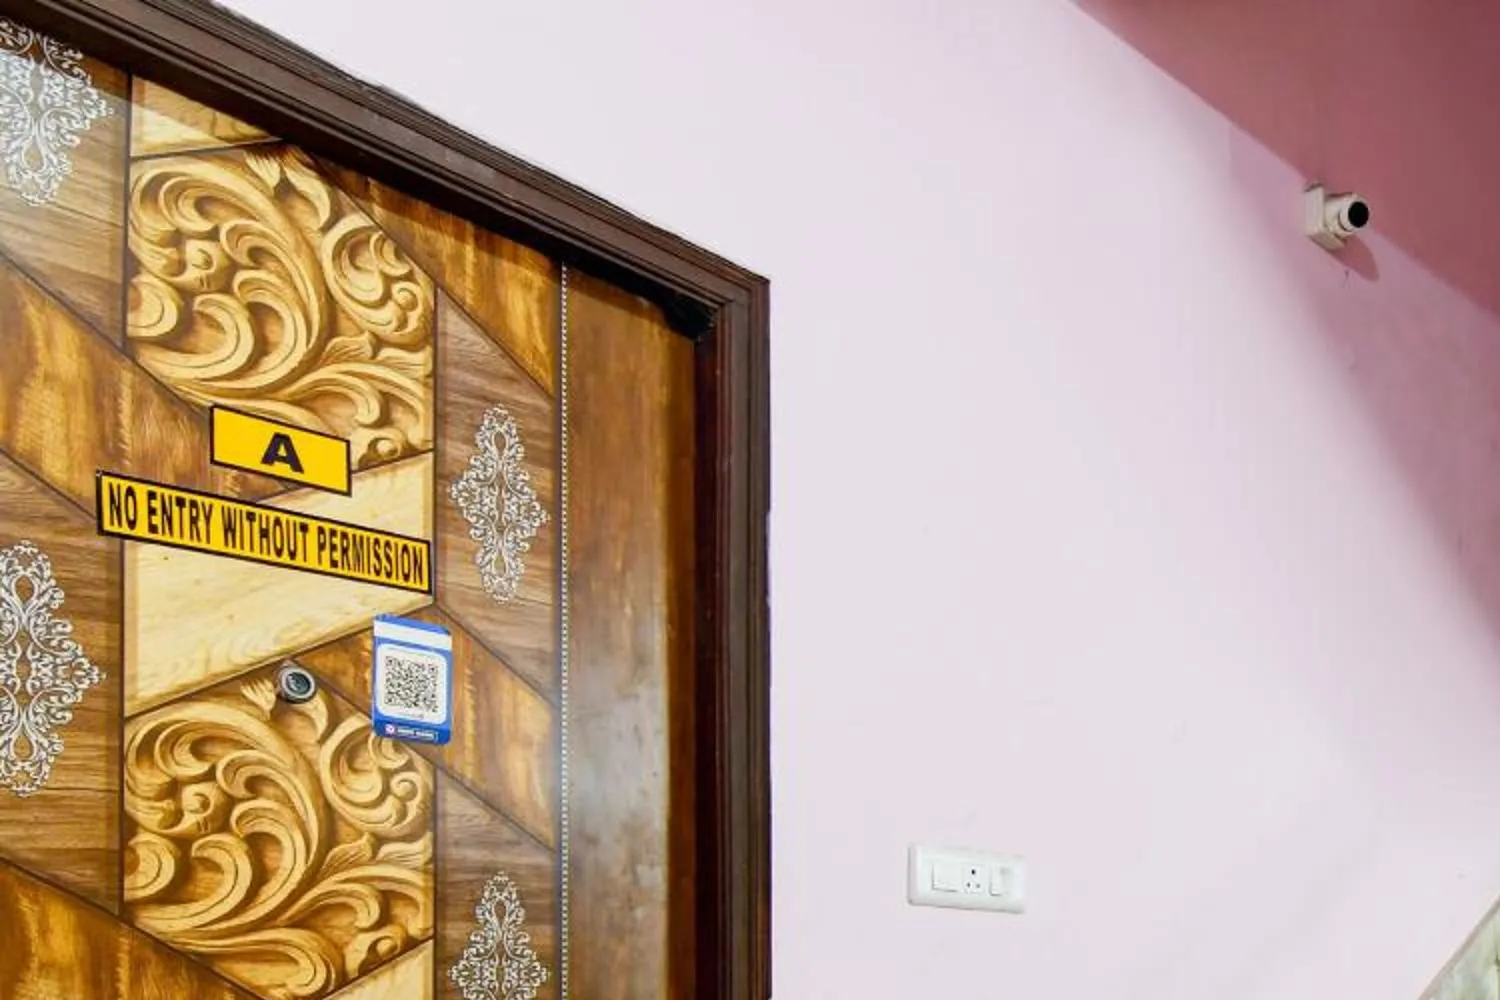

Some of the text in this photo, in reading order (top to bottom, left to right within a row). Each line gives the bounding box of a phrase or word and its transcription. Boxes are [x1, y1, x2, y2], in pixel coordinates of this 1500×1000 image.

[261, 433, 304, 474] A
[108, 481, 424, 585] NO ENTRY WITHOUT PERMISSION
